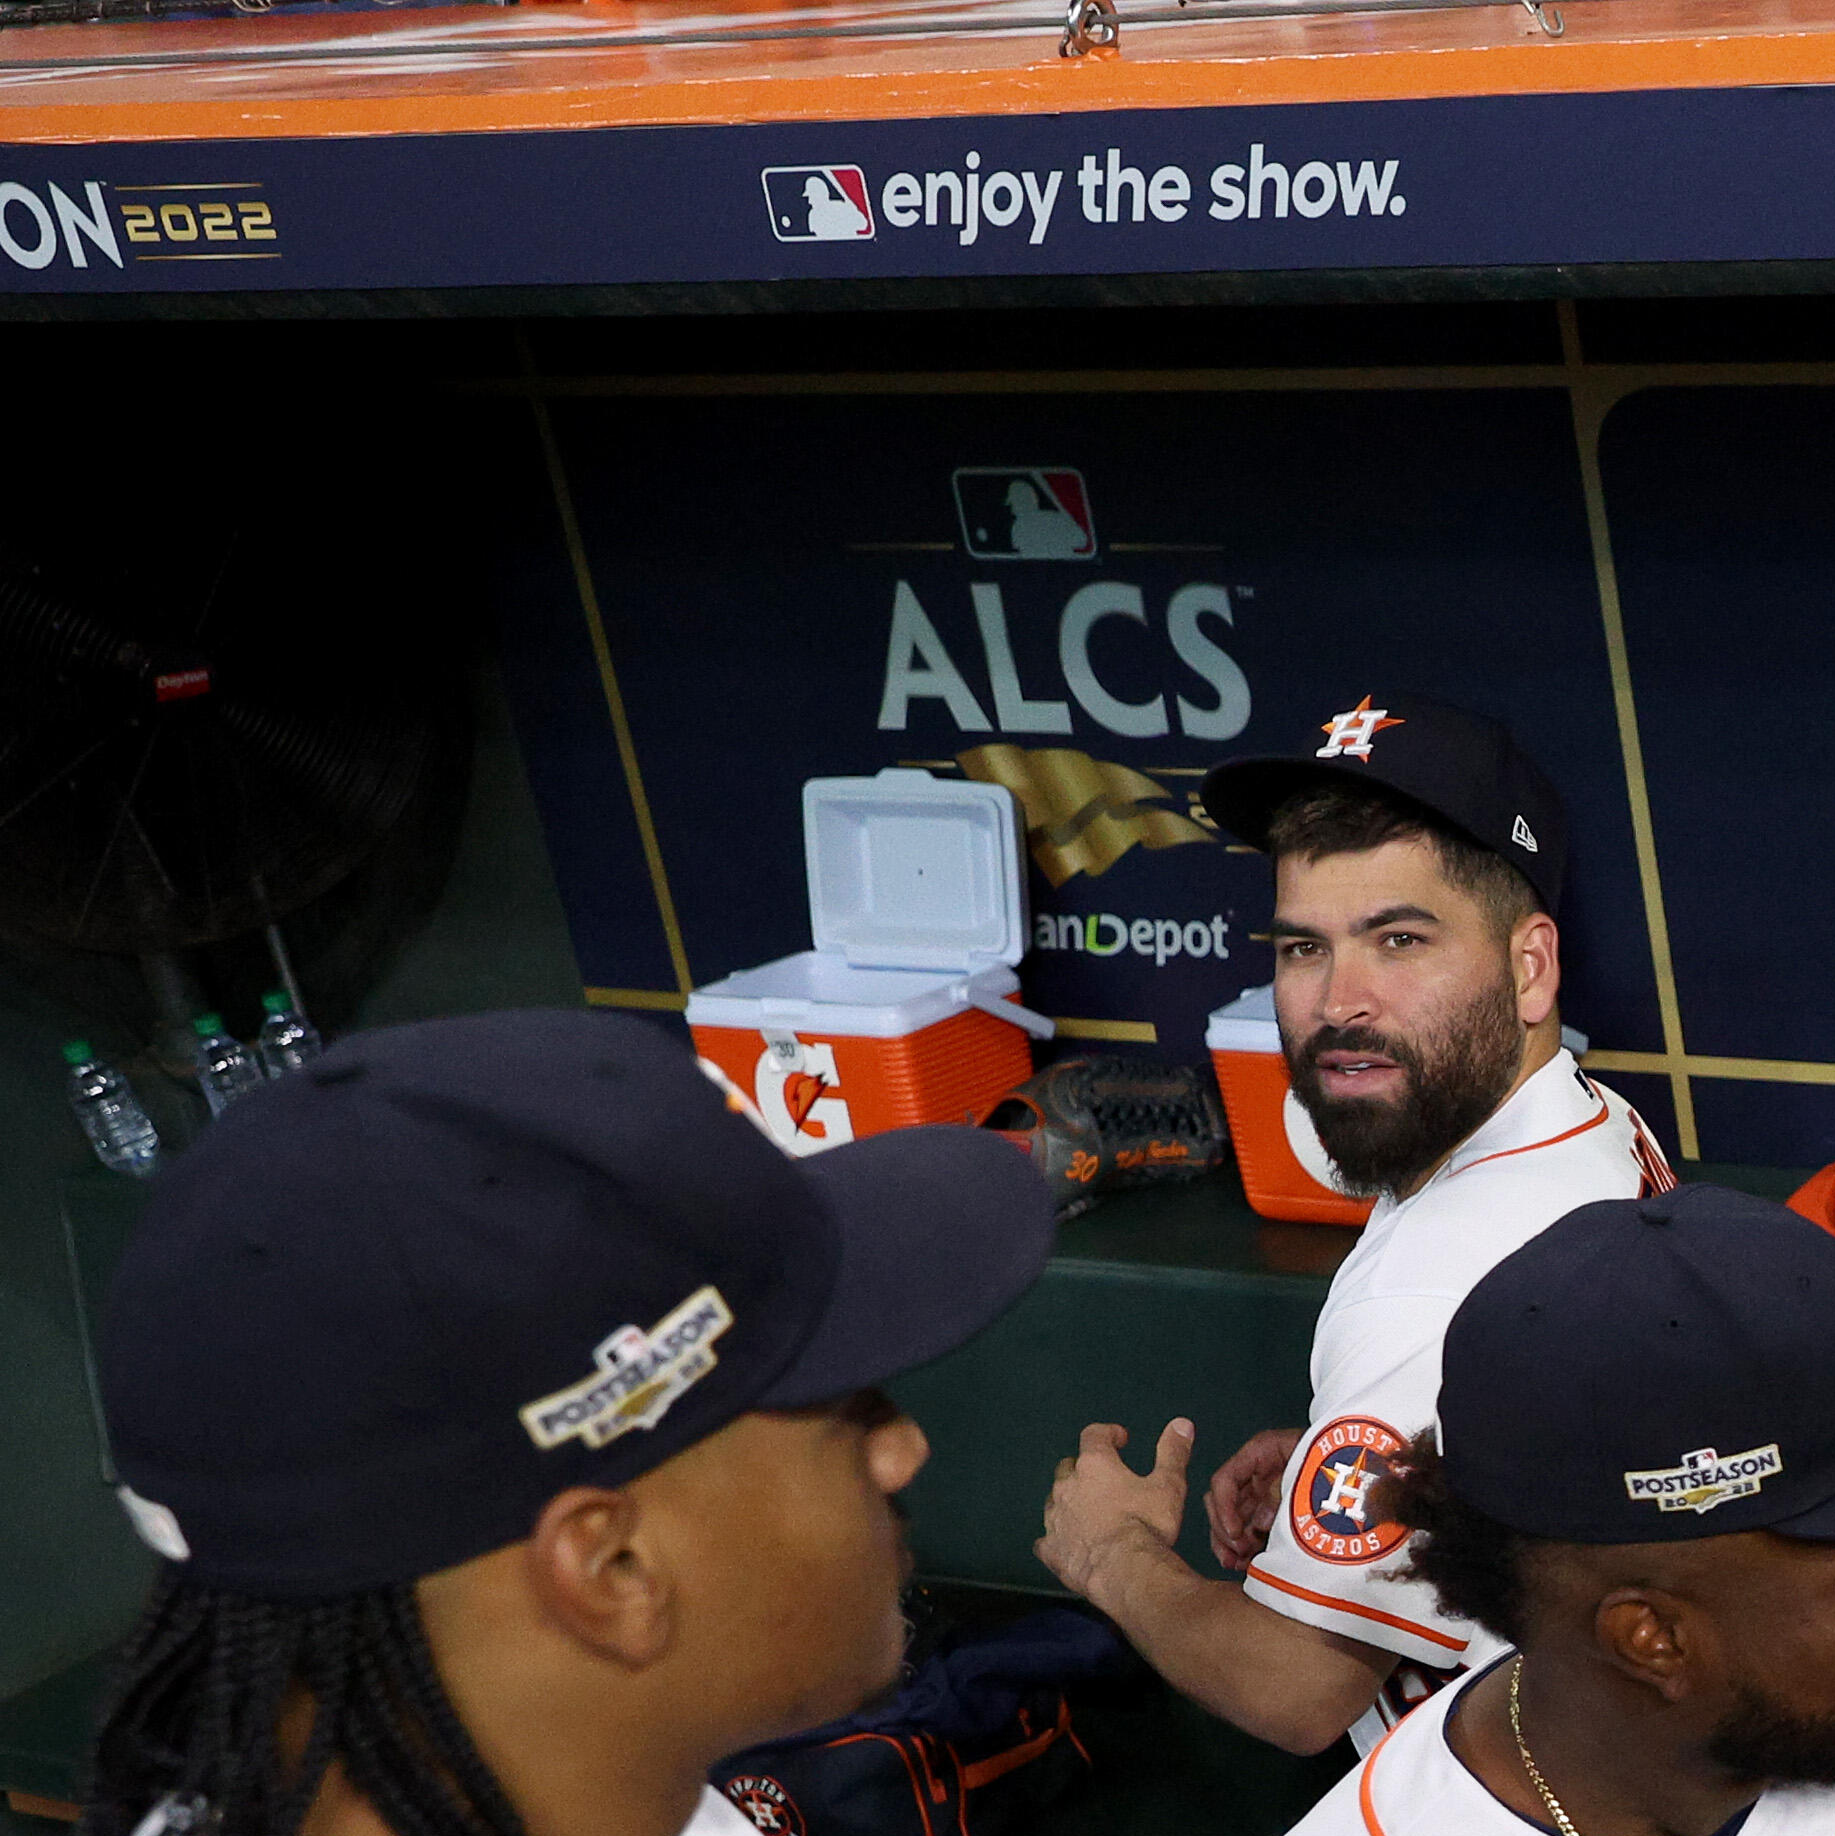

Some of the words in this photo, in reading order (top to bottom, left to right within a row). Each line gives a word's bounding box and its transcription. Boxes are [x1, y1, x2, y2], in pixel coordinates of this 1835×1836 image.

[882, 151, 1063, 246] enjoy
[1077, 147, 1191, 223] the
[1208, 143, 1407, 221] show.
[120, 201, 278, 242] 2022
[876, 579, 1253, 742] ALCS
[1632, 1452, 1776, 1494] POSTSEASON
[1294, 1512, 1382, 1556] ASTROS
